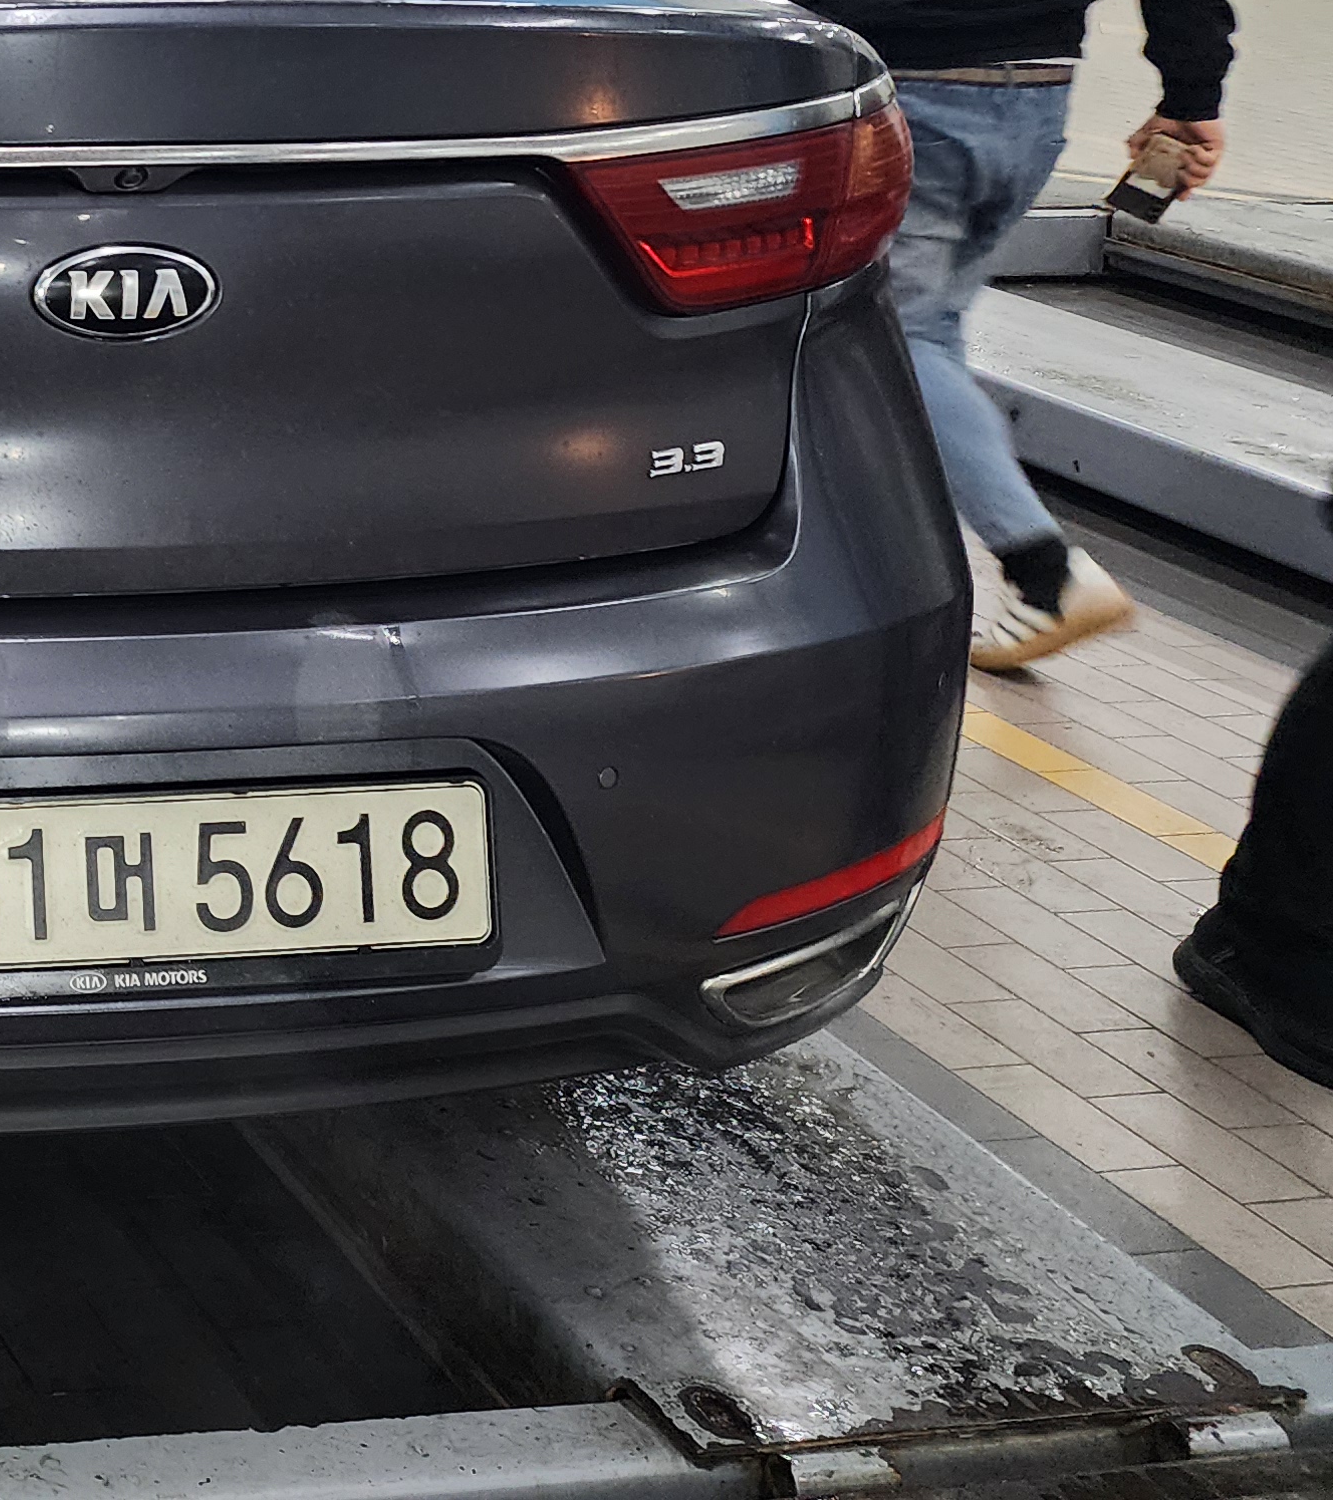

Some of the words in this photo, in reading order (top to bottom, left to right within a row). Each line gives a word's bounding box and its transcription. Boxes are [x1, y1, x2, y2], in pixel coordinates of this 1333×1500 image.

[67, 268, 189, 320] KIA
[649, 441, 725, 478] 3.3
[84, 832, 156, 932] 머
[194, 809, 460, 933] 5618
[114, 973, 140, 988] KIA
[144, 969, 208, 986] MOTORS
